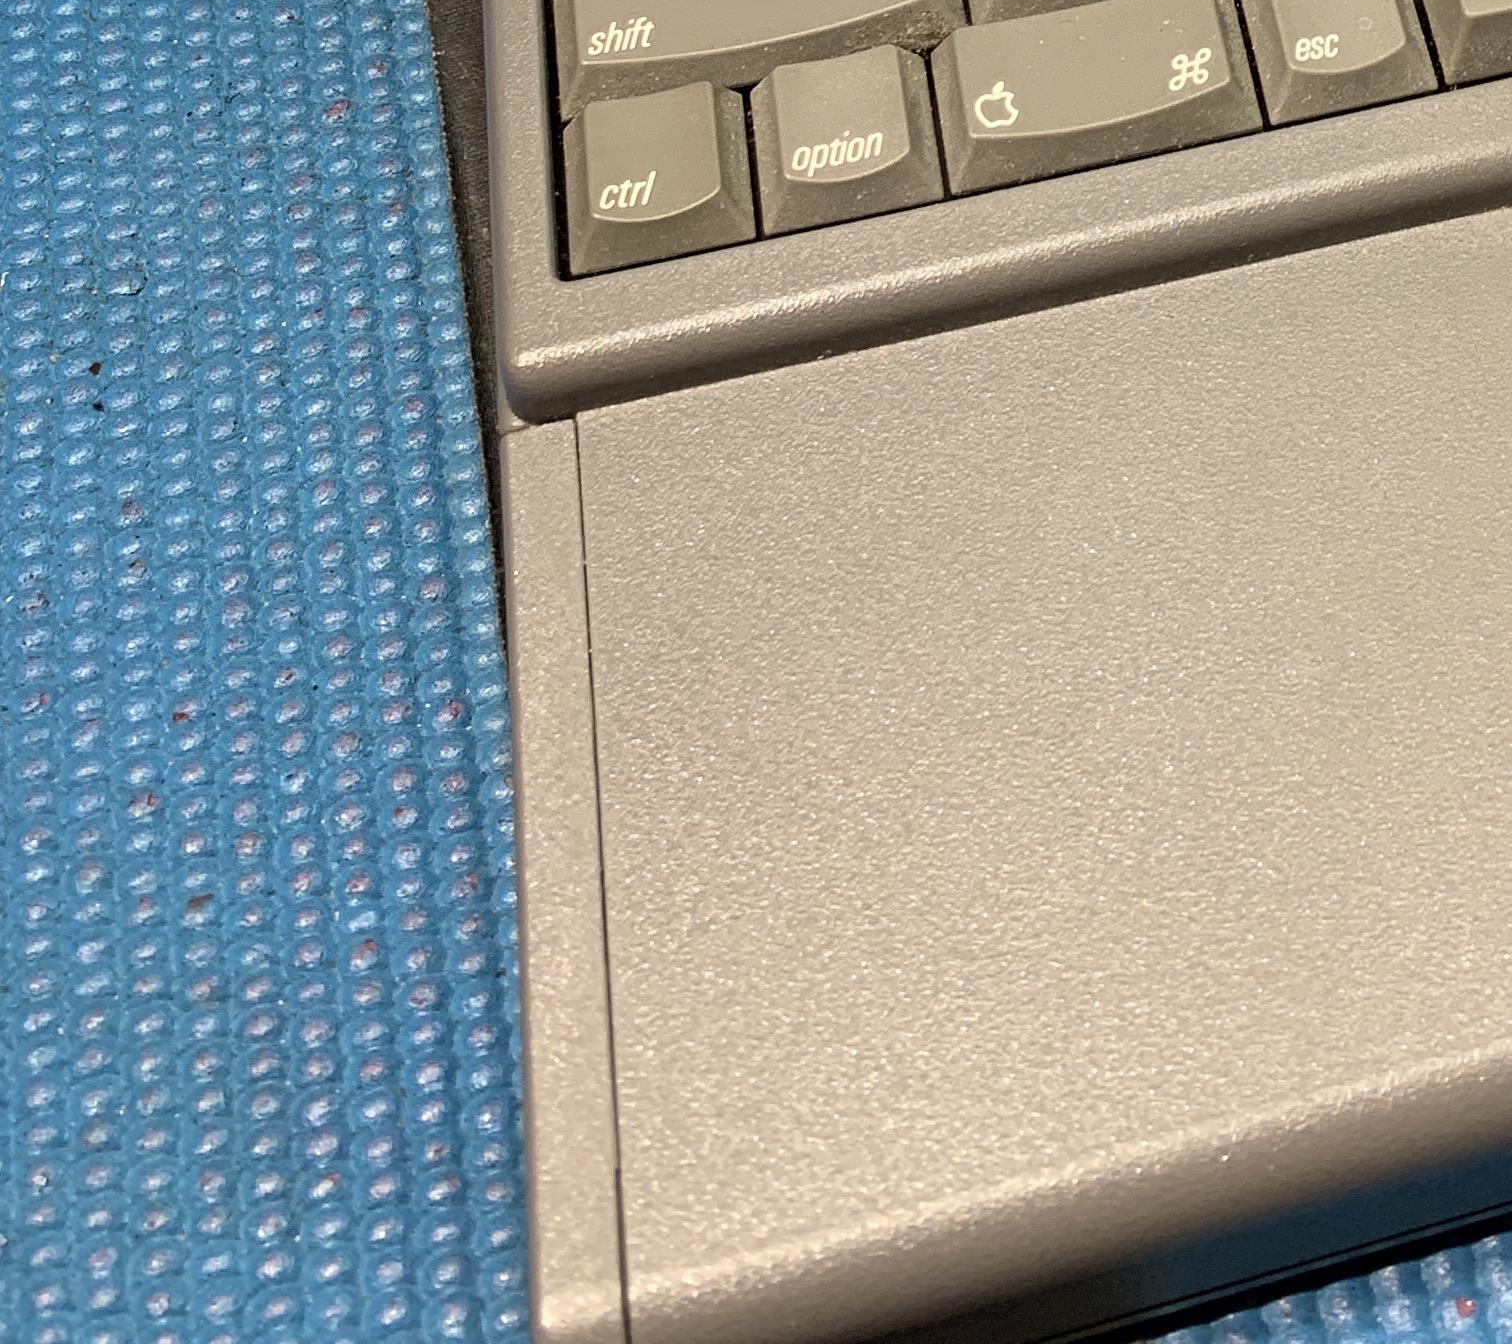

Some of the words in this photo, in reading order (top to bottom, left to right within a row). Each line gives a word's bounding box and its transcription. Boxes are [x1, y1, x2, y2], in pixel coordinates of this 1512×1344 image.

[587, 16, 655, 56] shift
[1295, 33, 1340, 62] esc
[792, 130, 884, 178] option
[599, 170, 658, 211] ctrl
